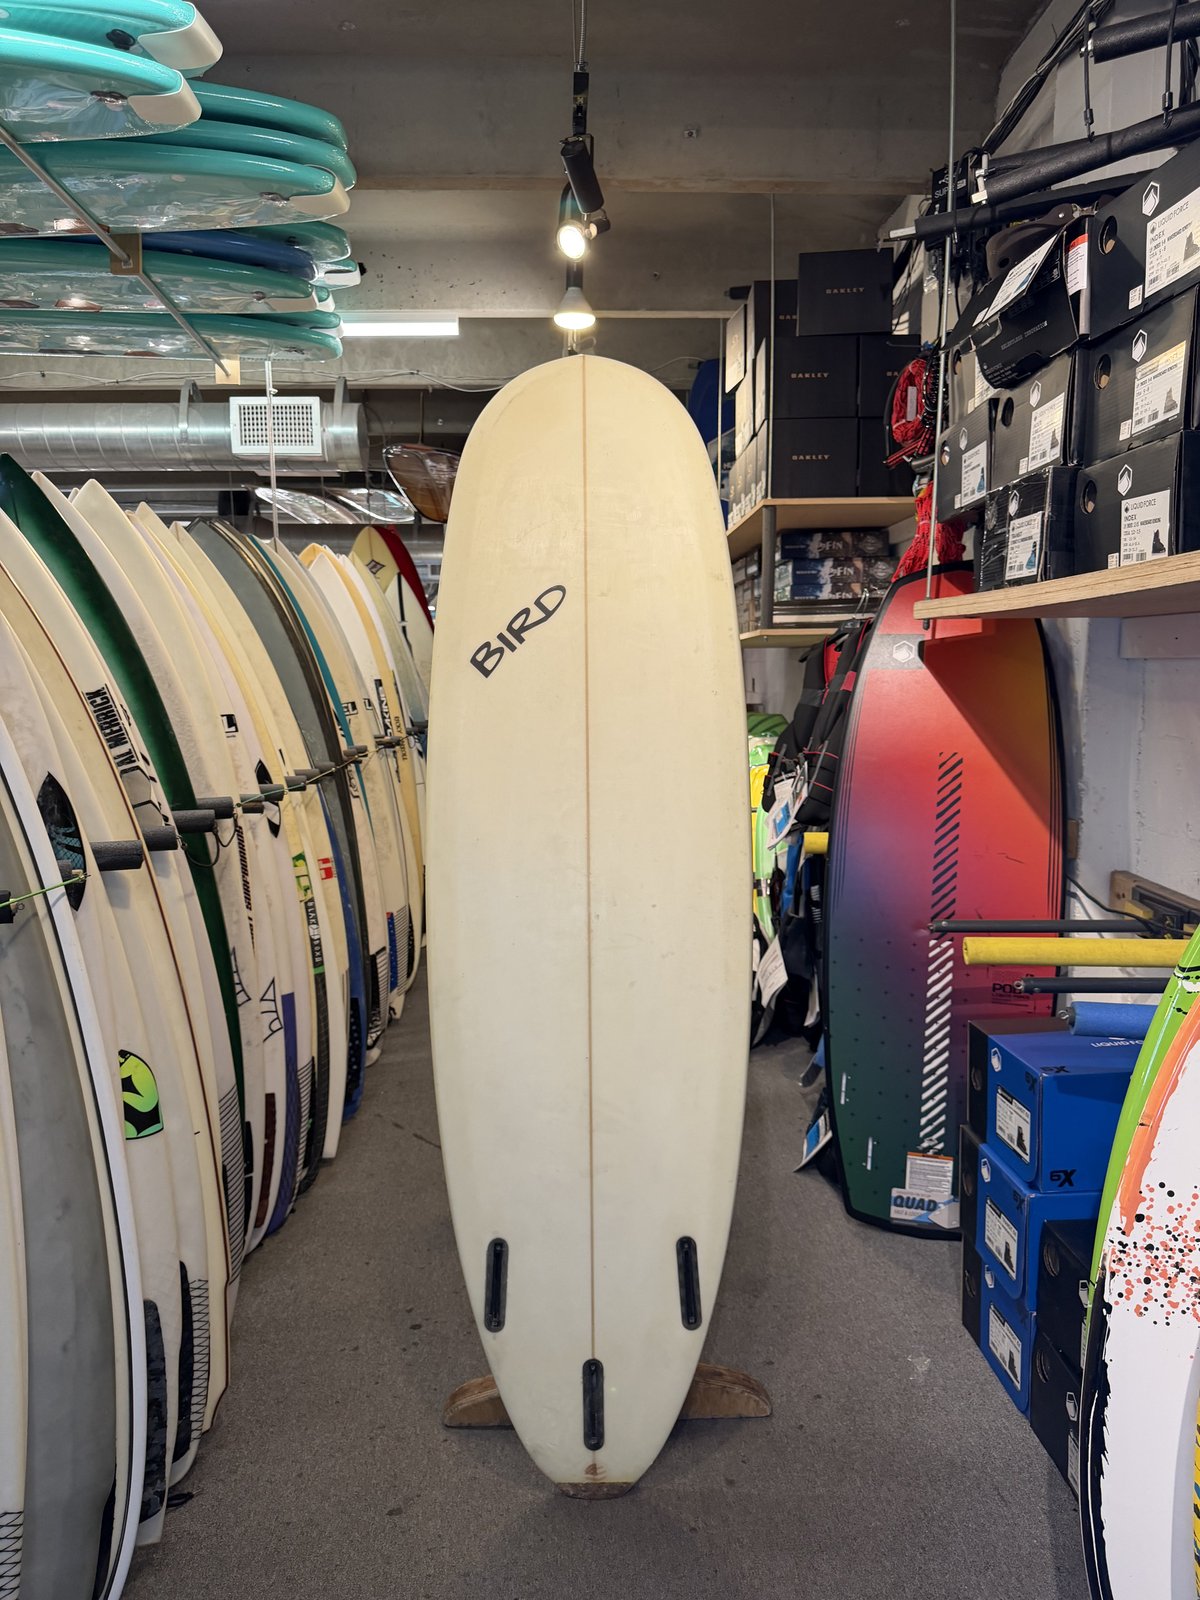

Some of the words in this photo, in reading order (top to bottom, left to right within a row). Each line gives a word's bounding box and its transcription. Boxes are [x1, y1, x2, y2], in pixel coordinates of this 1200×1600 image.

[469, 584, 567, 678] BIRD
[85, 686, 129, 750] MERRICK
[113, 748, 137, 768] AL
[1090, 1040, 1130, 1048] LIQUID
[1049, 1168, 1077, 1188] 6X
[893, 1195, 938, 1212] QUAD
